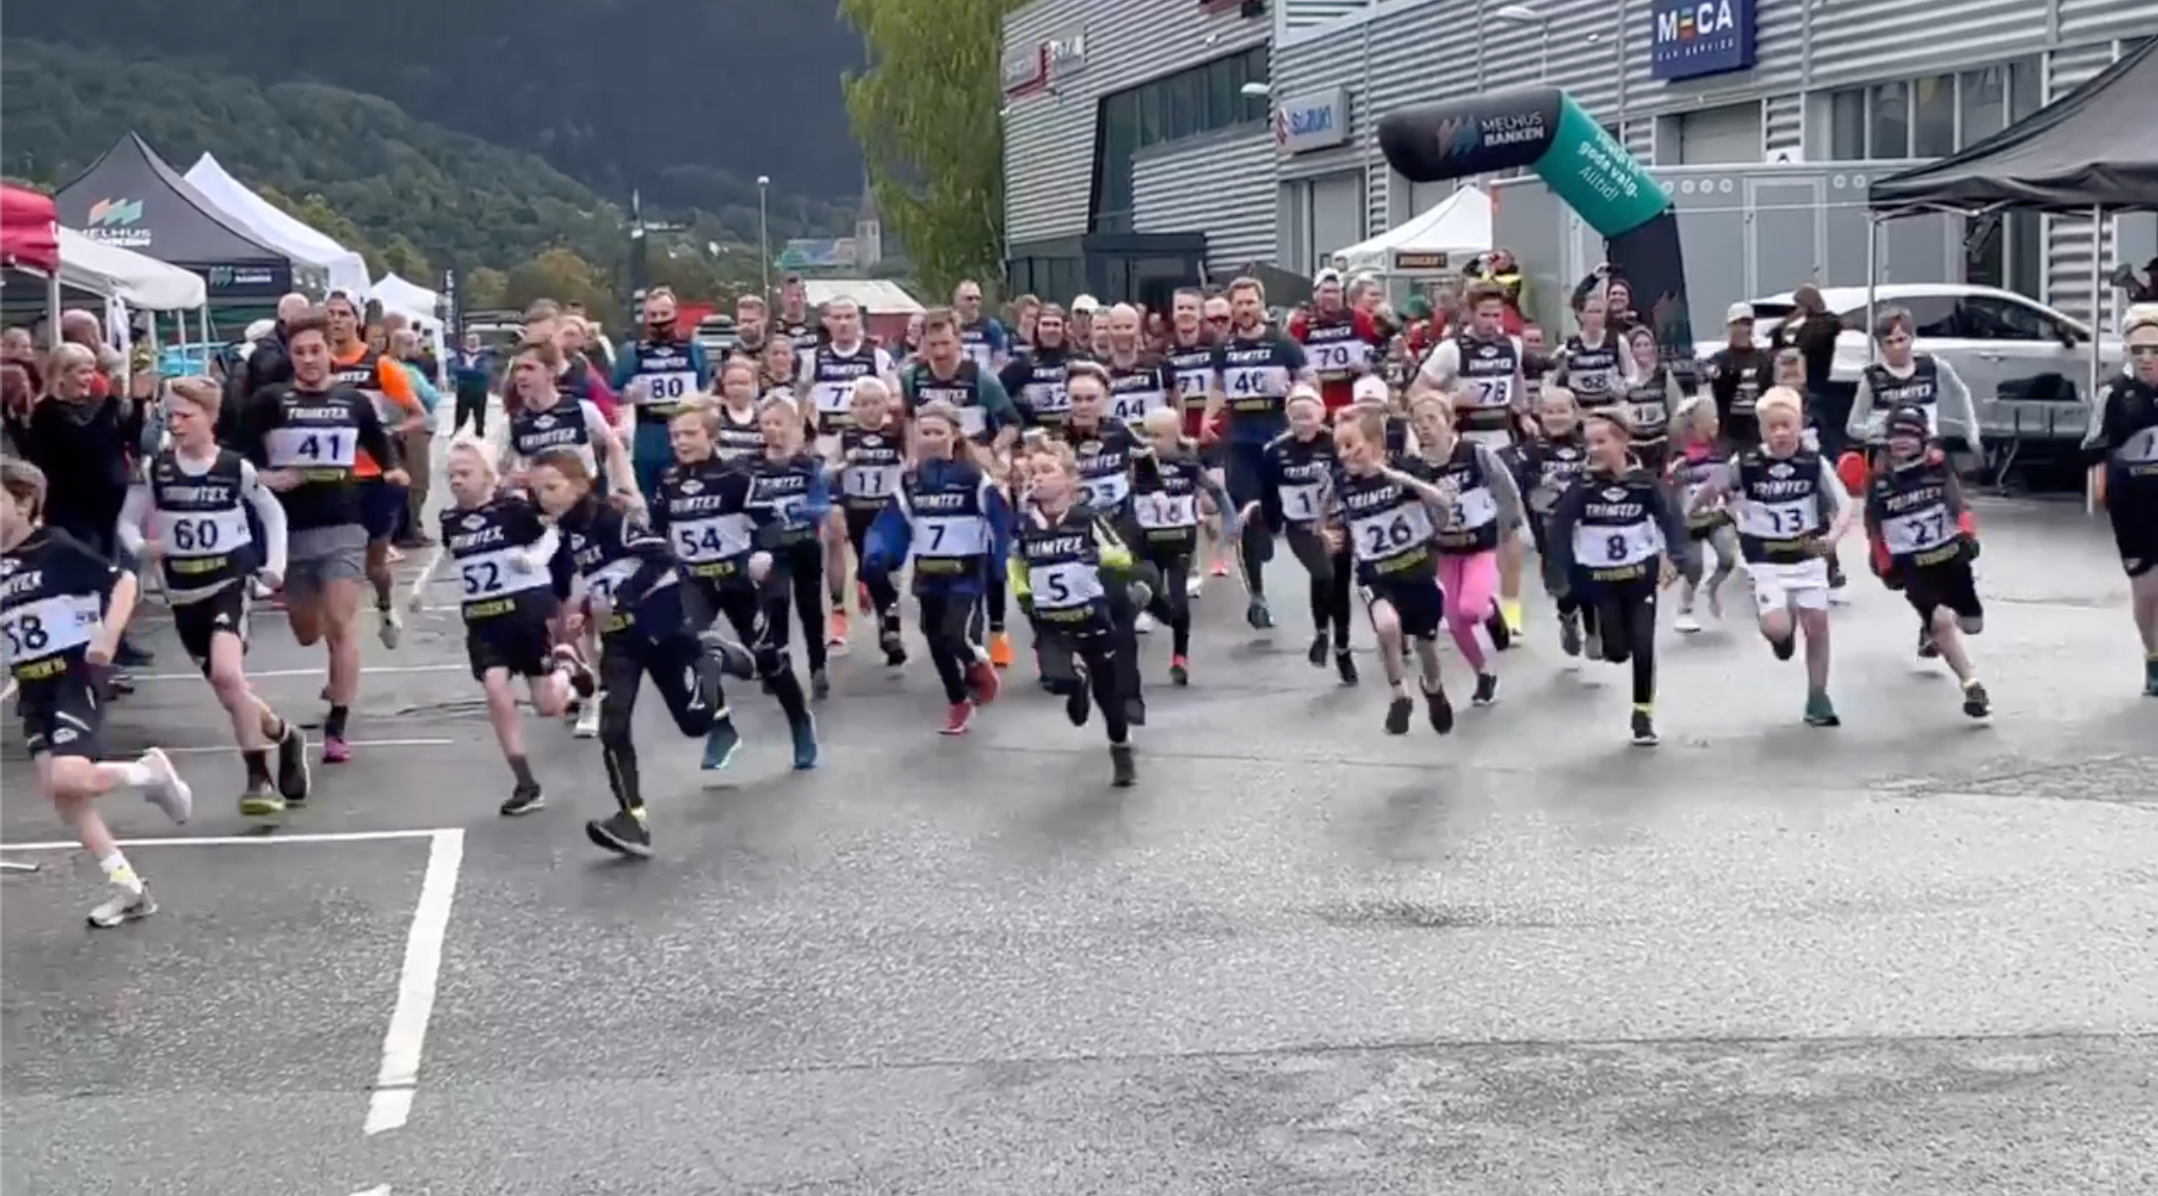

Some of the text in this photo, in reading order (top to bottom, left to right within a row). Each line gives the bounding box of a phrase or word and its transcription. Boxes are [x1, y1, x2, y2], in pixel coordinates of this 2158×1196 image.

[1658, 0, 1733, 43] MECA
[1482, 111, 1543, 133] MELHUS
[1484, 126, 1544, 147] BANKEN
[1577, 141, 1611, 171] gode
[1316, 346, 1349, 367] 70
[651, 377, 684, 399] 80
[1178, 374, 1205, 394] 71
[1115, 398, 1146, 419] 44
[298, 433, 340, 461] 41
[856, 471, 882, 495] 11
[174, 518, 218, 551] 60
[1367, 515, 1412, 554] 26
[1767, 509, 1804, 534] 13
[1907, 514, 1944, 546] 27
[680, 527, 722, 556] 54
[928, 524, 946, 552] 7
[1606, 533, 1628, 561] 8
[463, 561, 502, 594] 52
[1048, 573, 1068, 602] 5
